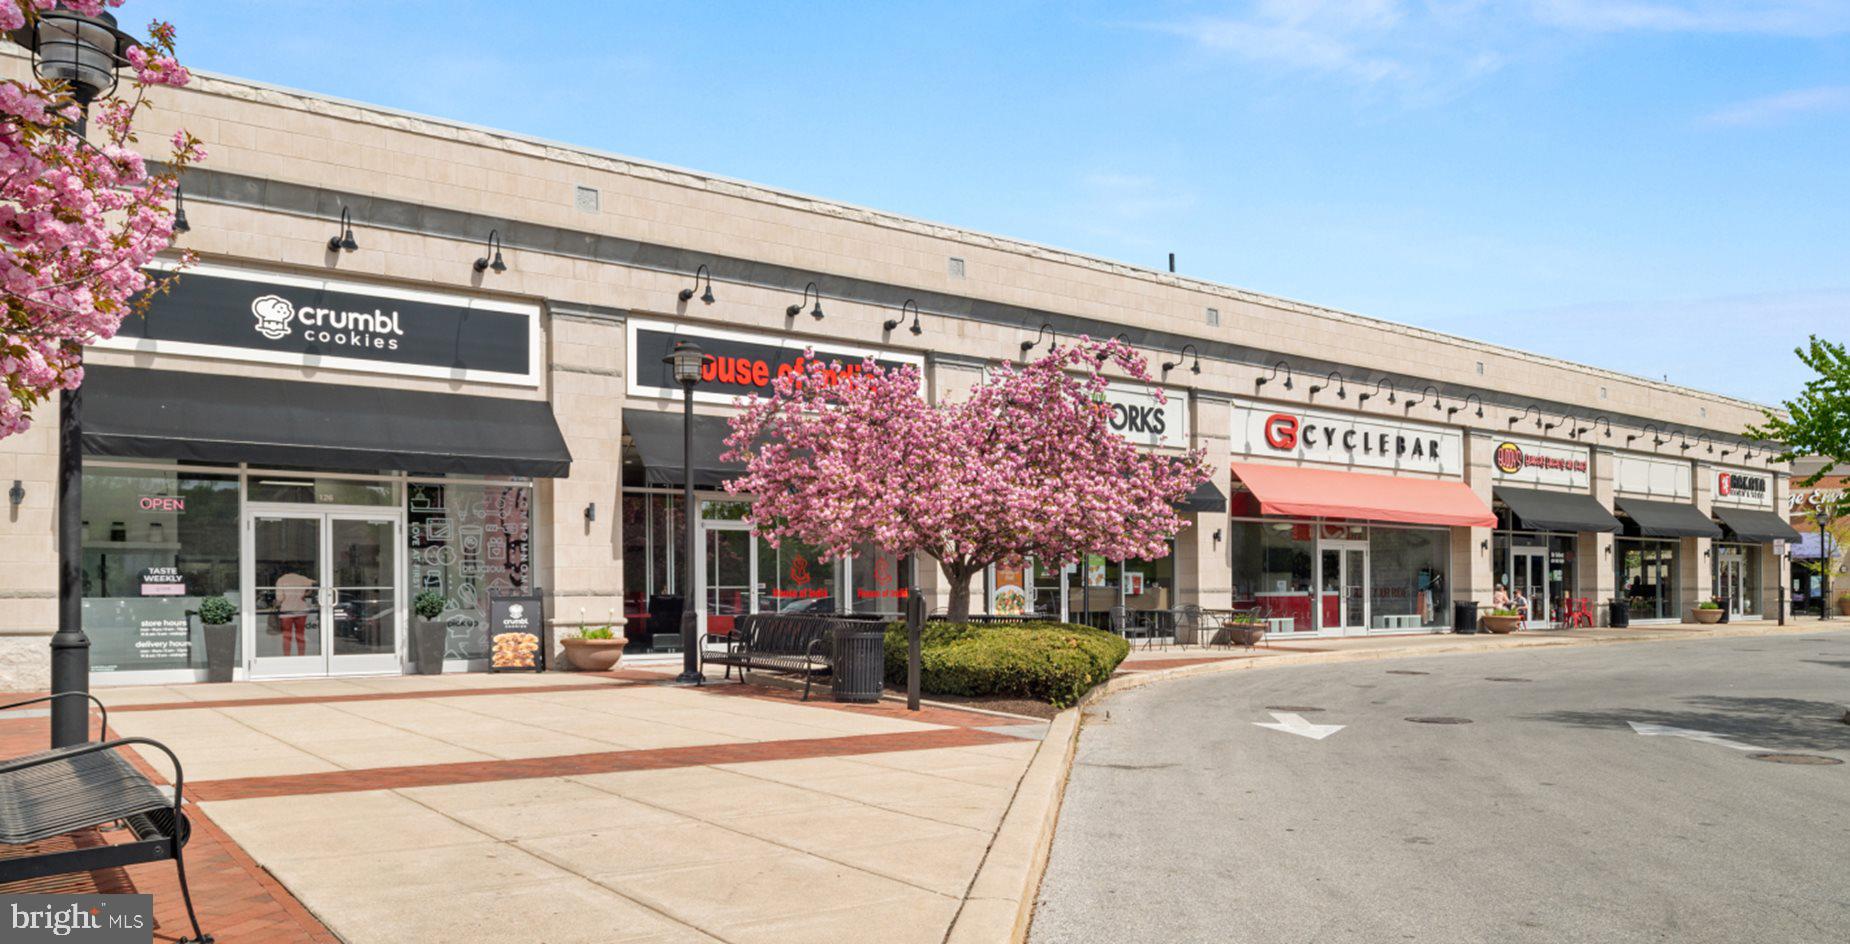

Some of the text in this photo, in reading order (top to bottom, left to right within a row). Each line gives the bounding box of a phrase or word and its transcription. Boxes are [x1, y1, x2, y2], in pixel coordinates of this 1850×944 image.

[298, 307, 403, 335] crumbl
[304, 330, 398, 350] cookies
[677, 343, 769, 387] ouse
[1098, 402, 1166, 435] ORKS
[1302, 424, 1439, 459] CYCLEBAR
[140, 497, 185, 511] OPEN
[411, 521, 420, 546] LOVE
[148, 567, 178, 575] TASTE
[163, 619, 187, 627] hours
[135, 640, 168, 648] delivery
